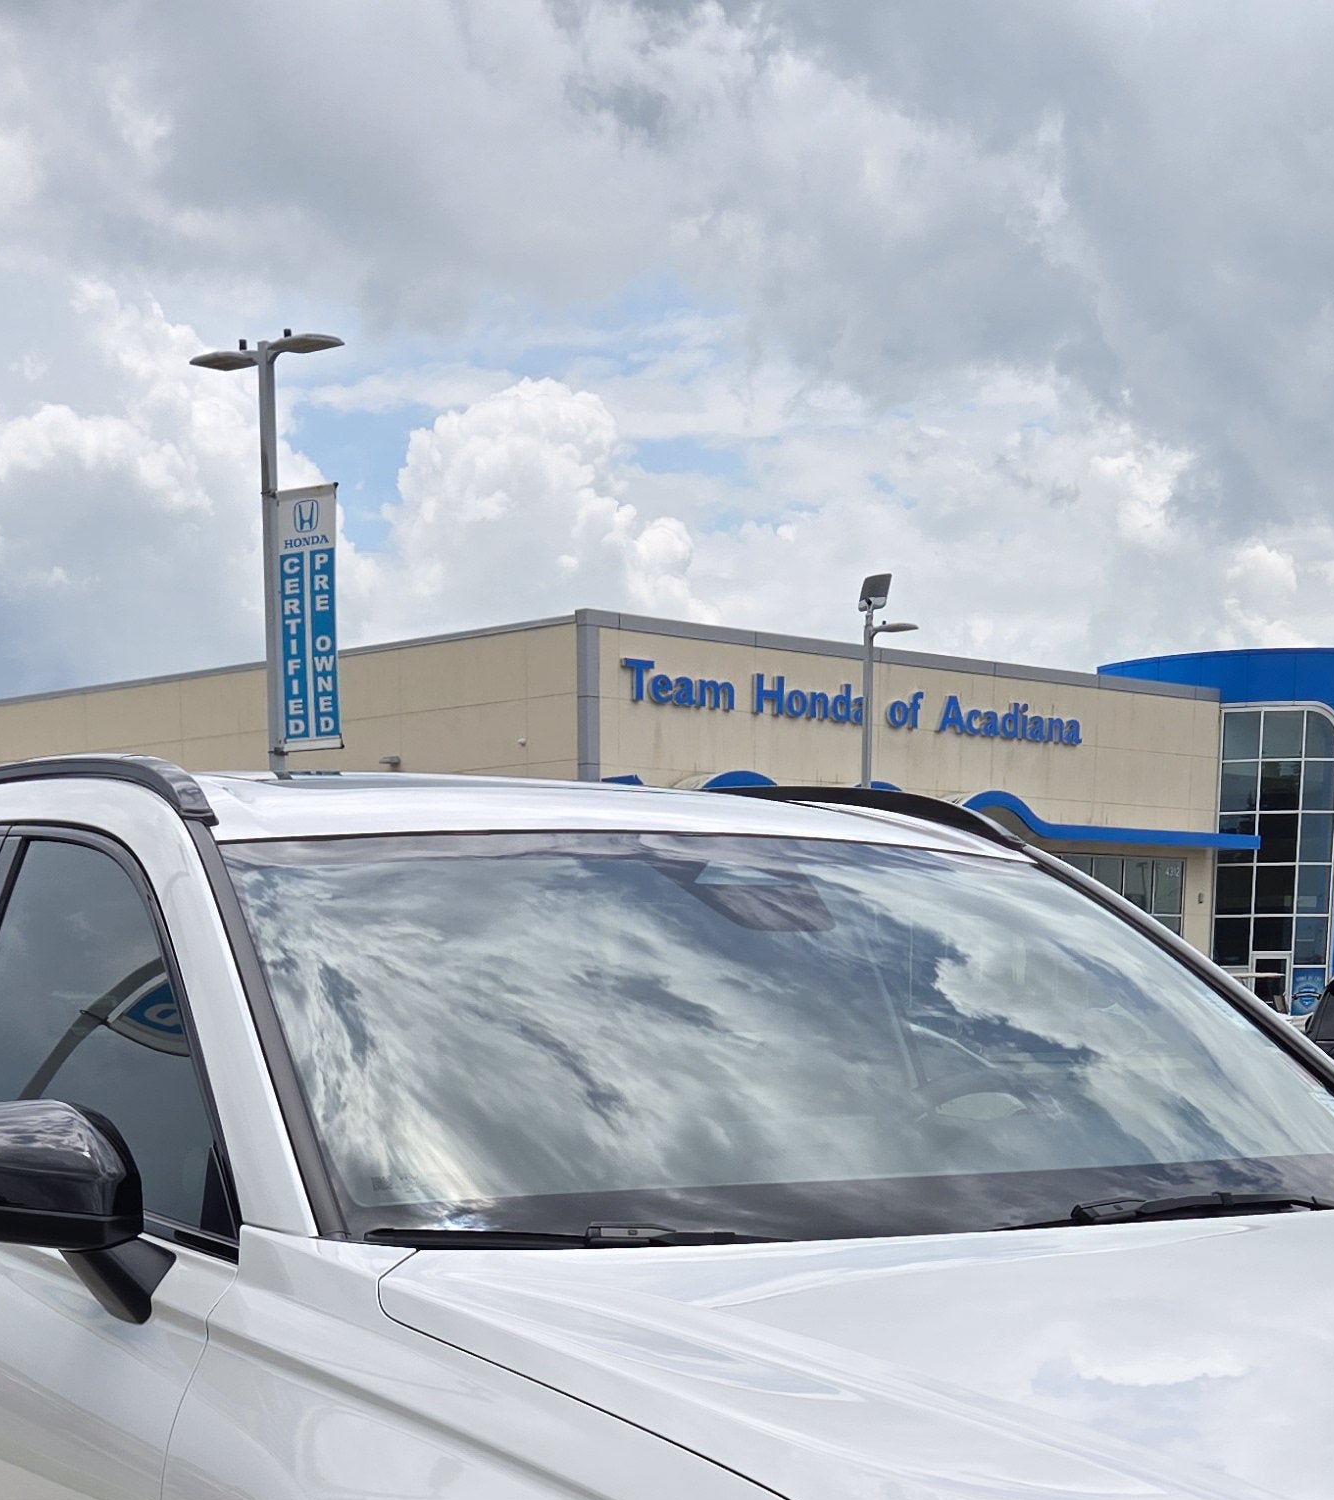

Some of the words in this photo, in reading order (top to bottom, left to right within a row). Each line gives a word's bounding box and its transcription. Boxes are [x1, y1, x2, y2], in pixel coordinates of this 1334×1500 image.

[284, 535, 329, 549] HONDA
[314, 553, 329, 611] PRE
[283, 557, 305, 736] CERTIFIED
[314, 635, 335, 734] OWNED
[621, 657, 735, 712] Team
[752, 672, 863, 726] Honda
[886, 691, 924, 730] of
[936, 695, 1082, 745] Acadiana
